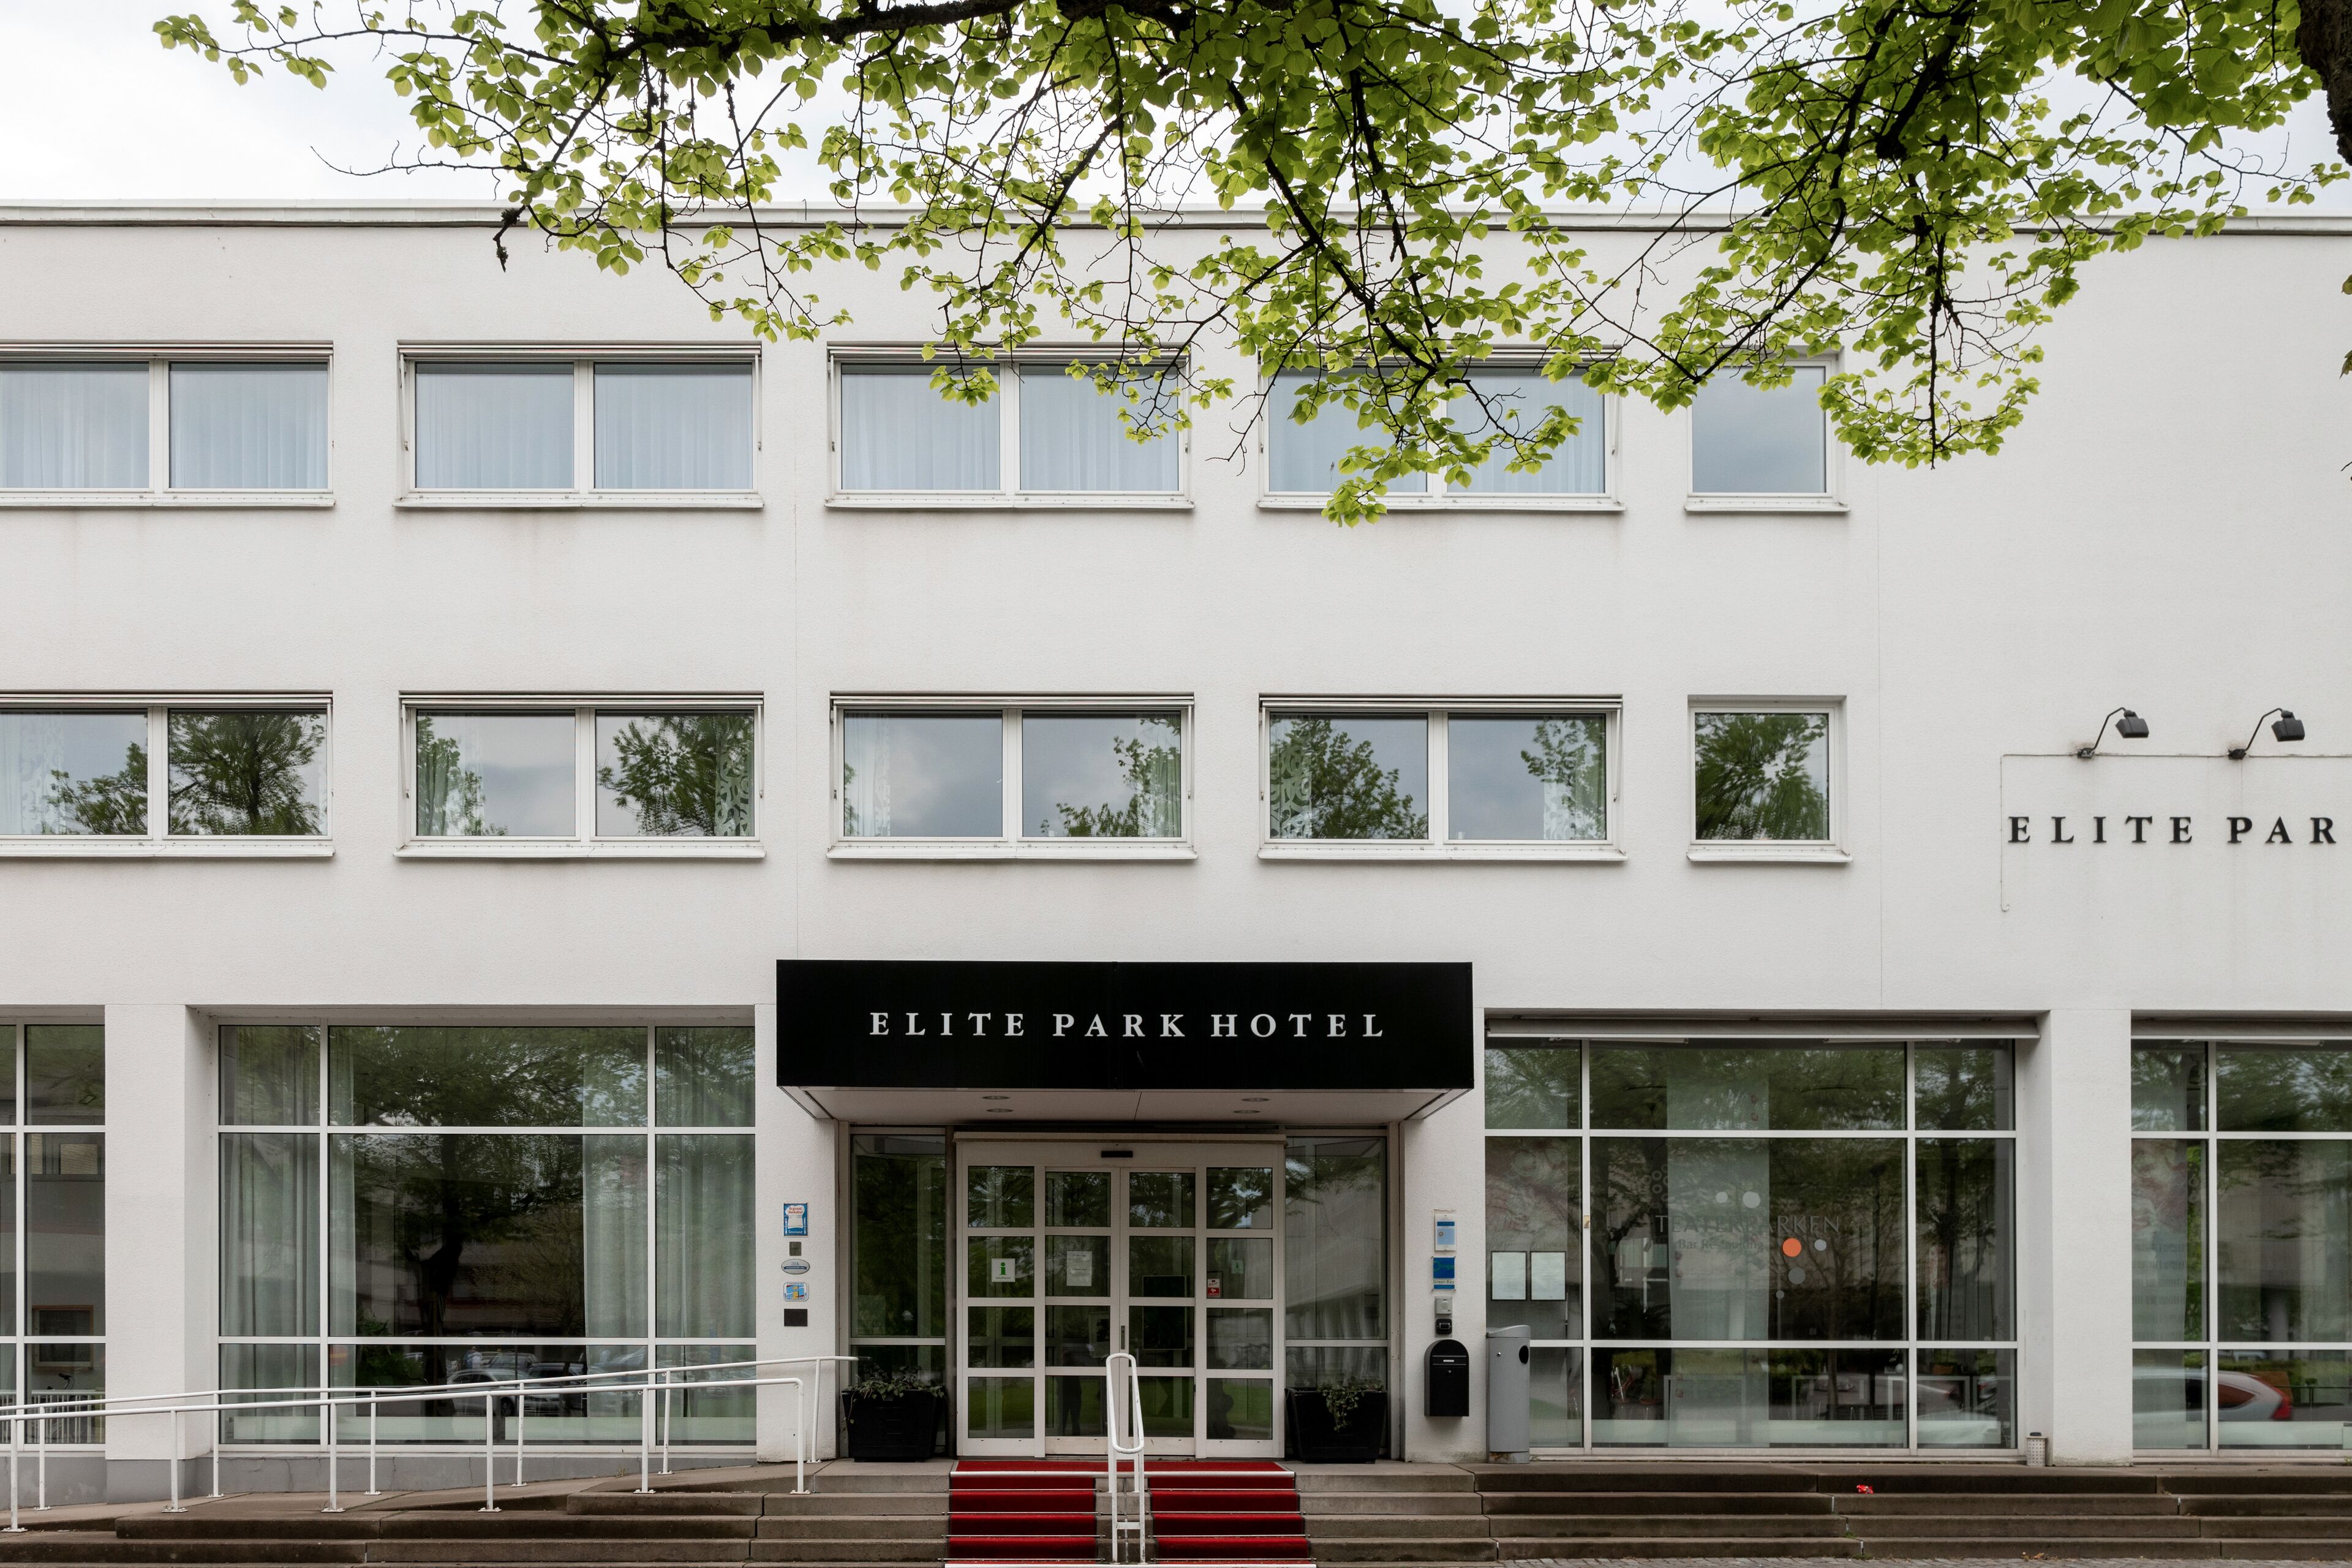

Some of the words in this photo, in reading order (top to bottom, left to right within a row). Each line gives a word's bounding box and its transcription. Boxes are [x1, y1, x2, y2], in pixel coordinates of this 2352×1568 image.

[2008, 816, 2192, 843] ELITE
[2227, 817, 2337, 843] PAR
[870, 1012, 1024, 1036] ELITE
[1053, 1014, 1185, 1037] PARK
[1211, 1014, 1383, 1038] HOTEL
[1679, 1239, 1697, 1250] Bar
